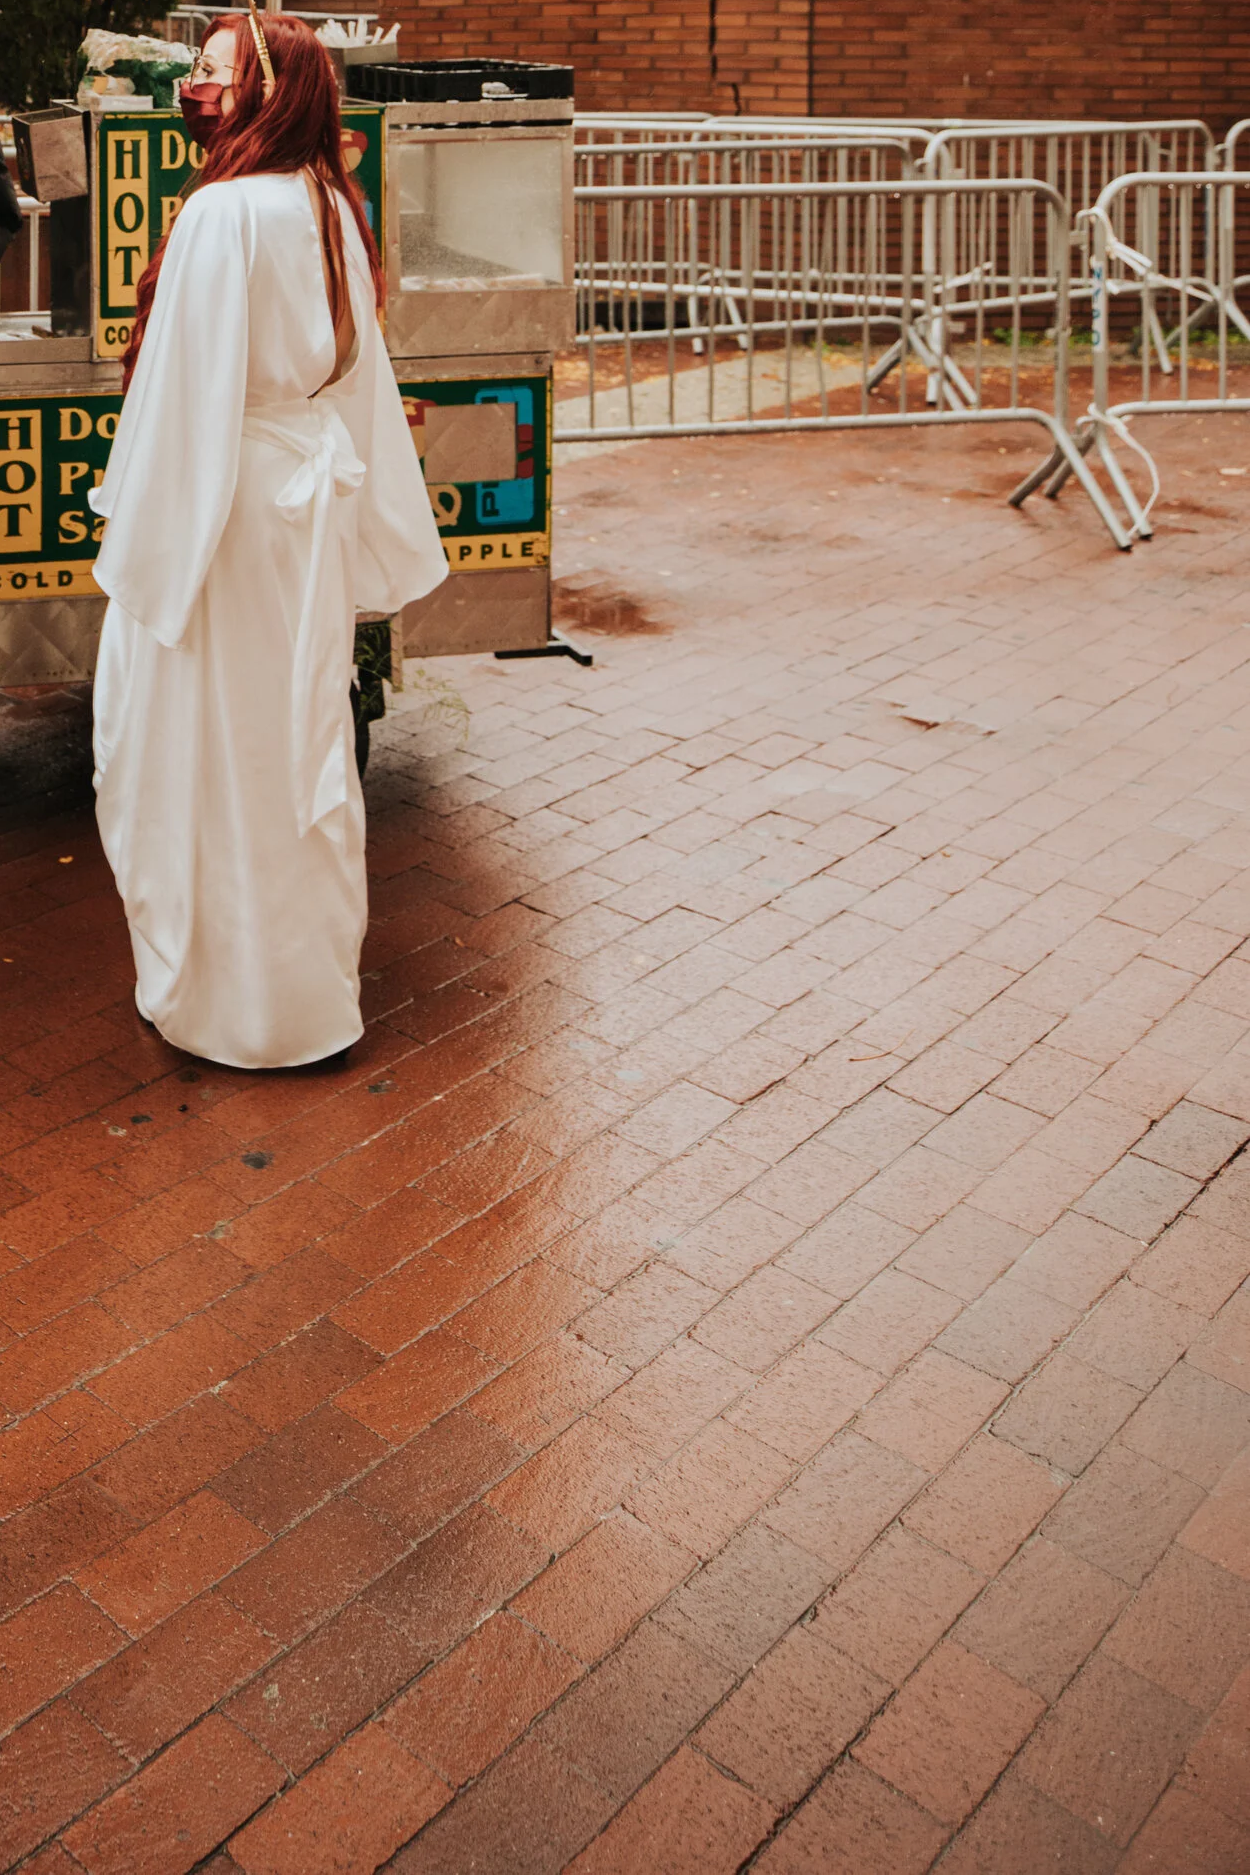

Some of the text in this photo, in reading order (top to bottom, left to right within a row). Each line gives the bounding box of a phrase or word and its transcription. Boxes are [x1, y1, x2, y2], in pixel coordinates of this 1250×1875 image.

[160, 130, 208, 170] Do
[113, 139, 145, 286] HOT
[104, 326, 131, 345] CO
[58, 407, 120, 441] Do
[443, 541, 535, 563] PPLE
